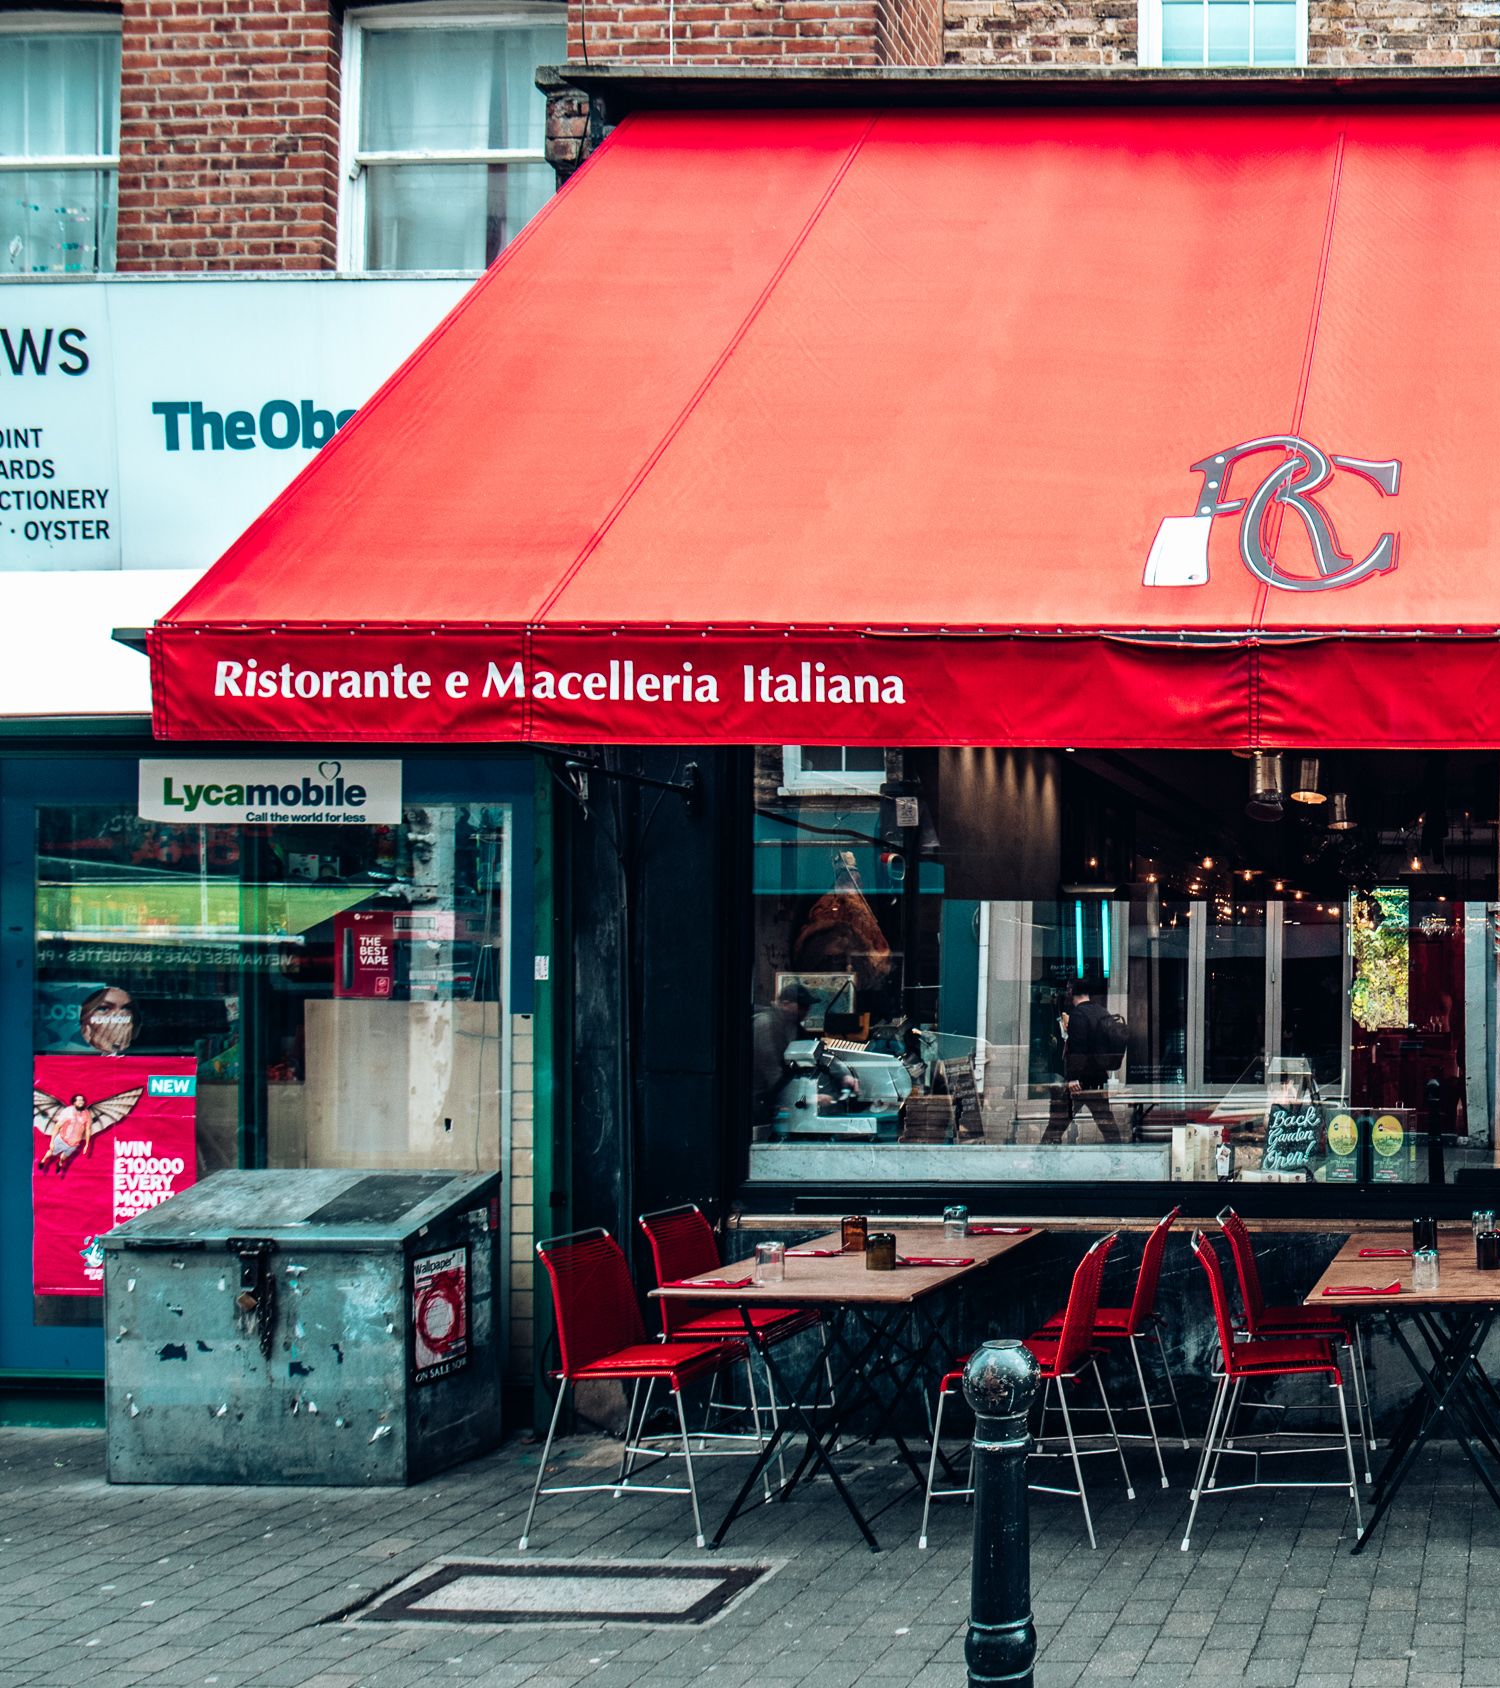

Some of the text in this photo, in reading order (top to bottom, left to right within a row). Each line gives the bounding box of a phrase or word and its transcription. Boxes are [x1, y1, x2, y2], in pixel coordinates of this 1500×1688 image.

[24, 520, 110, 541] OYSTER
[213, 658, 906, 703] Ristorante e Macelleria Italiana
[163, 776, 367, 812] Lycamobile
[245, 812, 366, 823] Call the world for less
[359, 937, 381, 947] THE
[359, 947, 387, 956] BEST
[359, 956, 389, 965] VAPE
[151, 1079, 190, 1093] NEW
[1270, 1106, 1320, 1128] Back
[1267, 1128, 1314, 1151] Garden
[116, 1141, 152, 1157] WIN
[115, 1158, 184, 1175] £10,000
[115, 1174, 175, 1191] EVERY
[114, 1207, 135, 1217] FOR
[415, 1371, 428, 1383] ON
[429, 1364, 450, 1378] SALE
